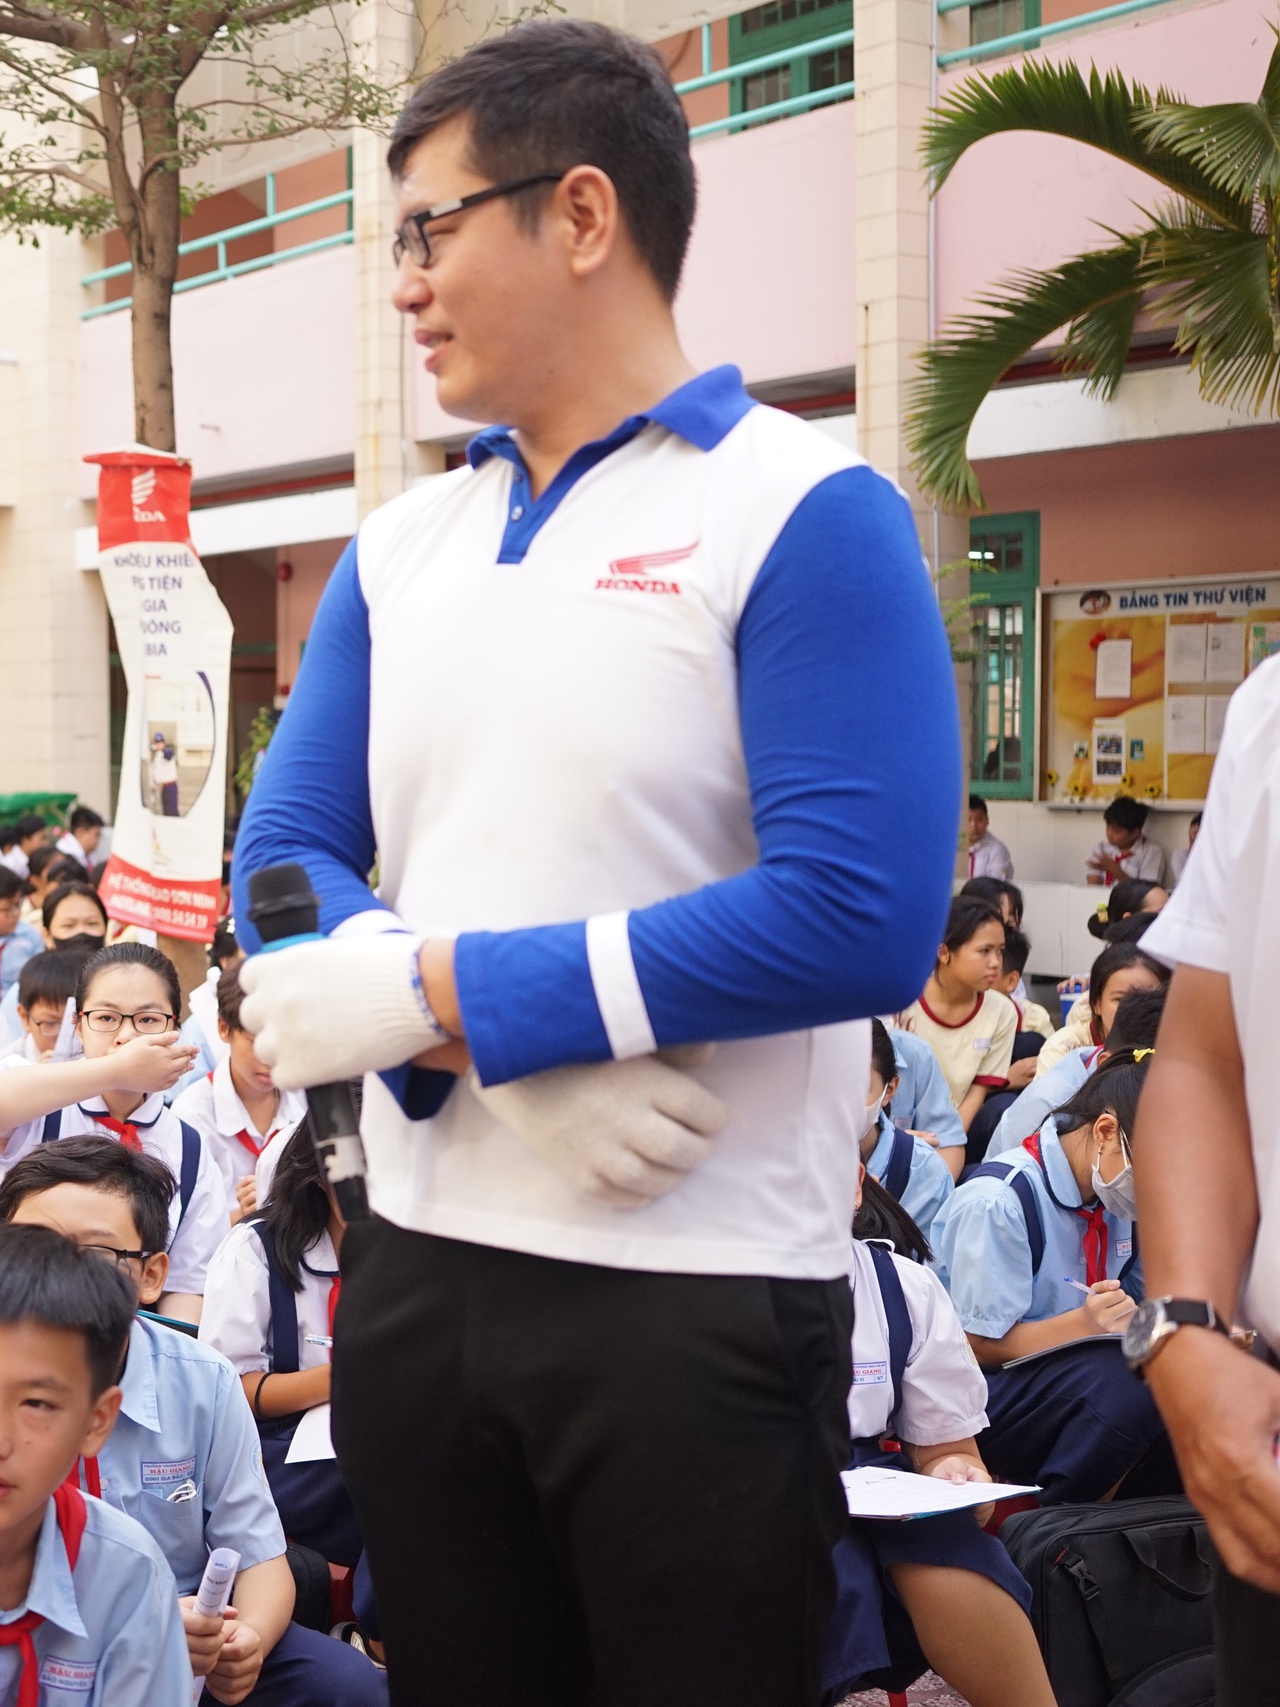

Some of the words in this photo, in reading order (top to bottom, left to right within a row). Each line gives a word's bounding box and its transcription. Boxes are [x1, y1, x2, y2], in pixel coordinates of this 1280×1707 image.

[149, 573, 183, 595] TIỆN
[595, 579, 681, 595] HONDA
[1119, 590, 1159, 609] BẢNG
[1163, 591, 1189, 607] TIN
[1193, 587, 1226, 605] THƯ
[1229, 585, 1266, 607] VIỆN
